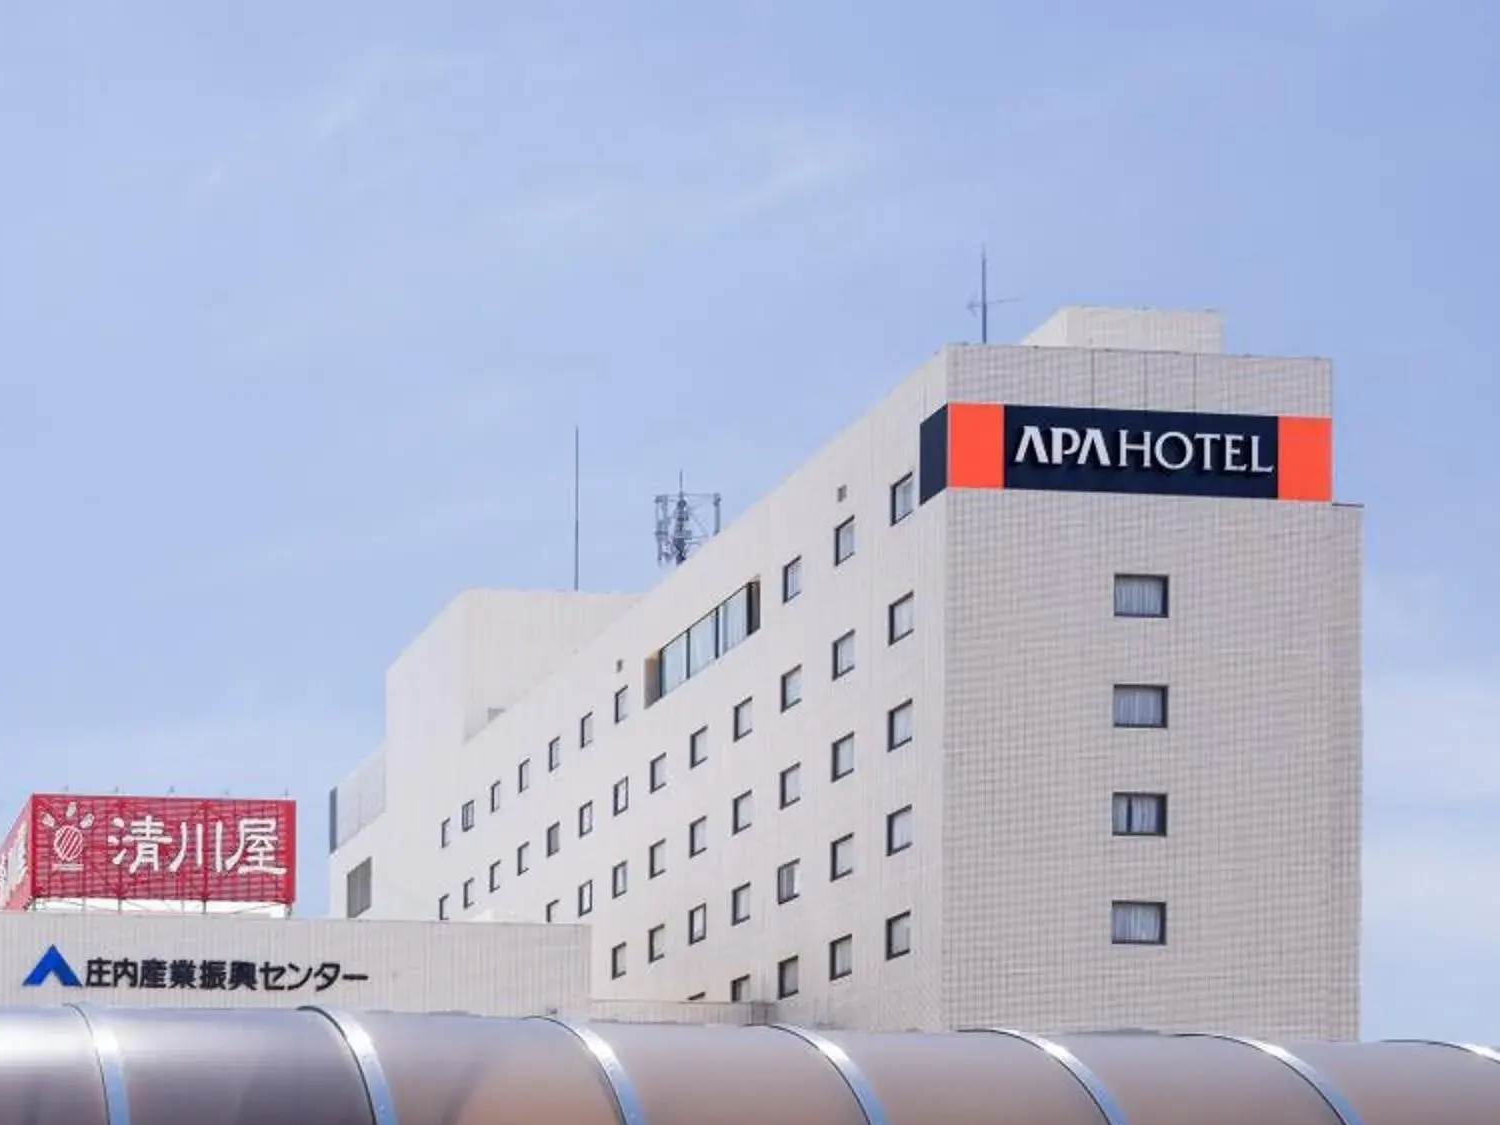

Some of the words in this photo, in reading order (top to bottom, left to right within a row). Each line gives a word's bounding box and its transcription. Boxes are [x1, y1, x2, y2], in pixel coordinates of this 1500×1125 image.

[1014, 424, 1110, 466] APA
[1117, 428, 1274, 474] HOTEL
[106, 816, 287, 876] 清川屋
[85, 957, 370, 992] 庄内産業振興センター
